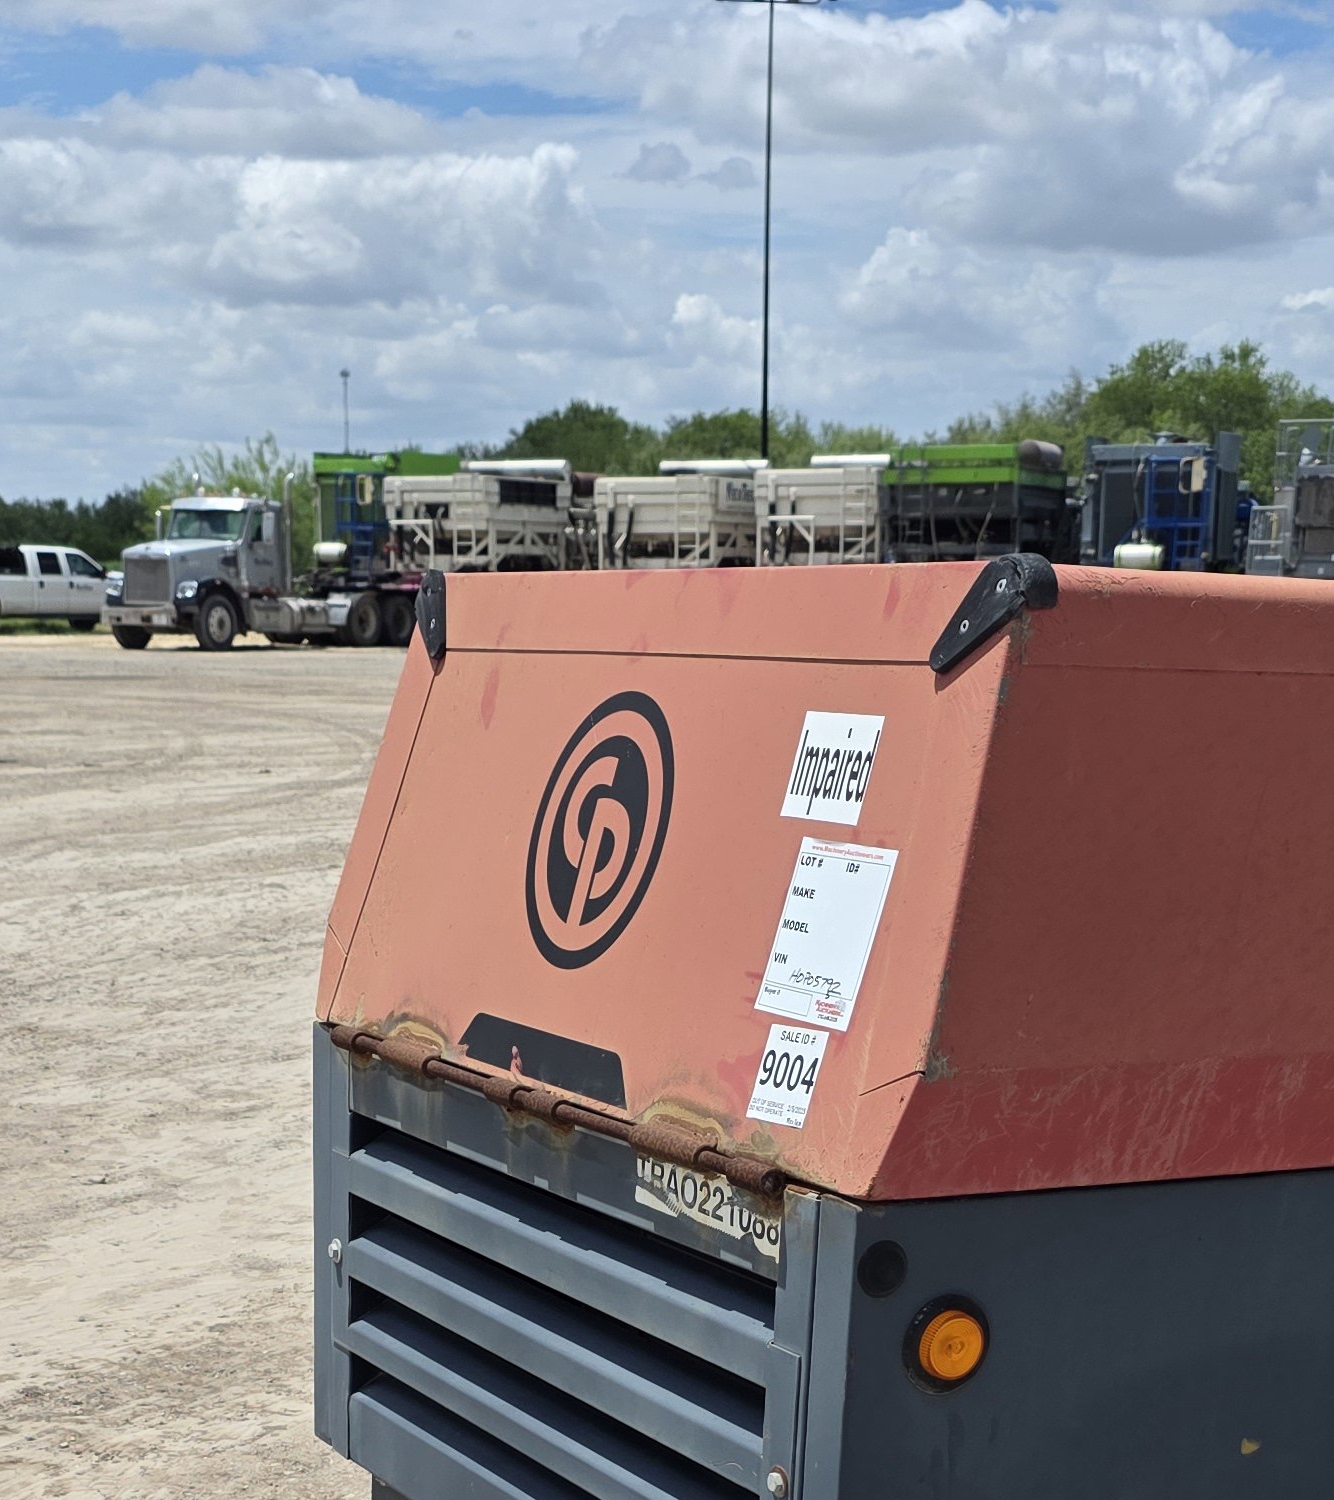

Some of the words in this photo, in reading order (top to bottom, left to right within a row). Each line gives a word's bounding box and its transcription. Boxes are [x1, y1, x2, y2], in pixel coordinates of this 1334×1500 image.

[790, 727, 880, 815] Impaired
[800, 855, 818, 867] LOT
[845, 862, 861, 875] ID#
[792, 885, 816, 899] MAKE
[782, 919, 809, 934] MODEL
[773, 952, 788, 965] VIN
[780, 1030, 801, 1044] SALE
[801, 1032, 810, 1045] ID
[759, 1049, 819, 1094] 9004
